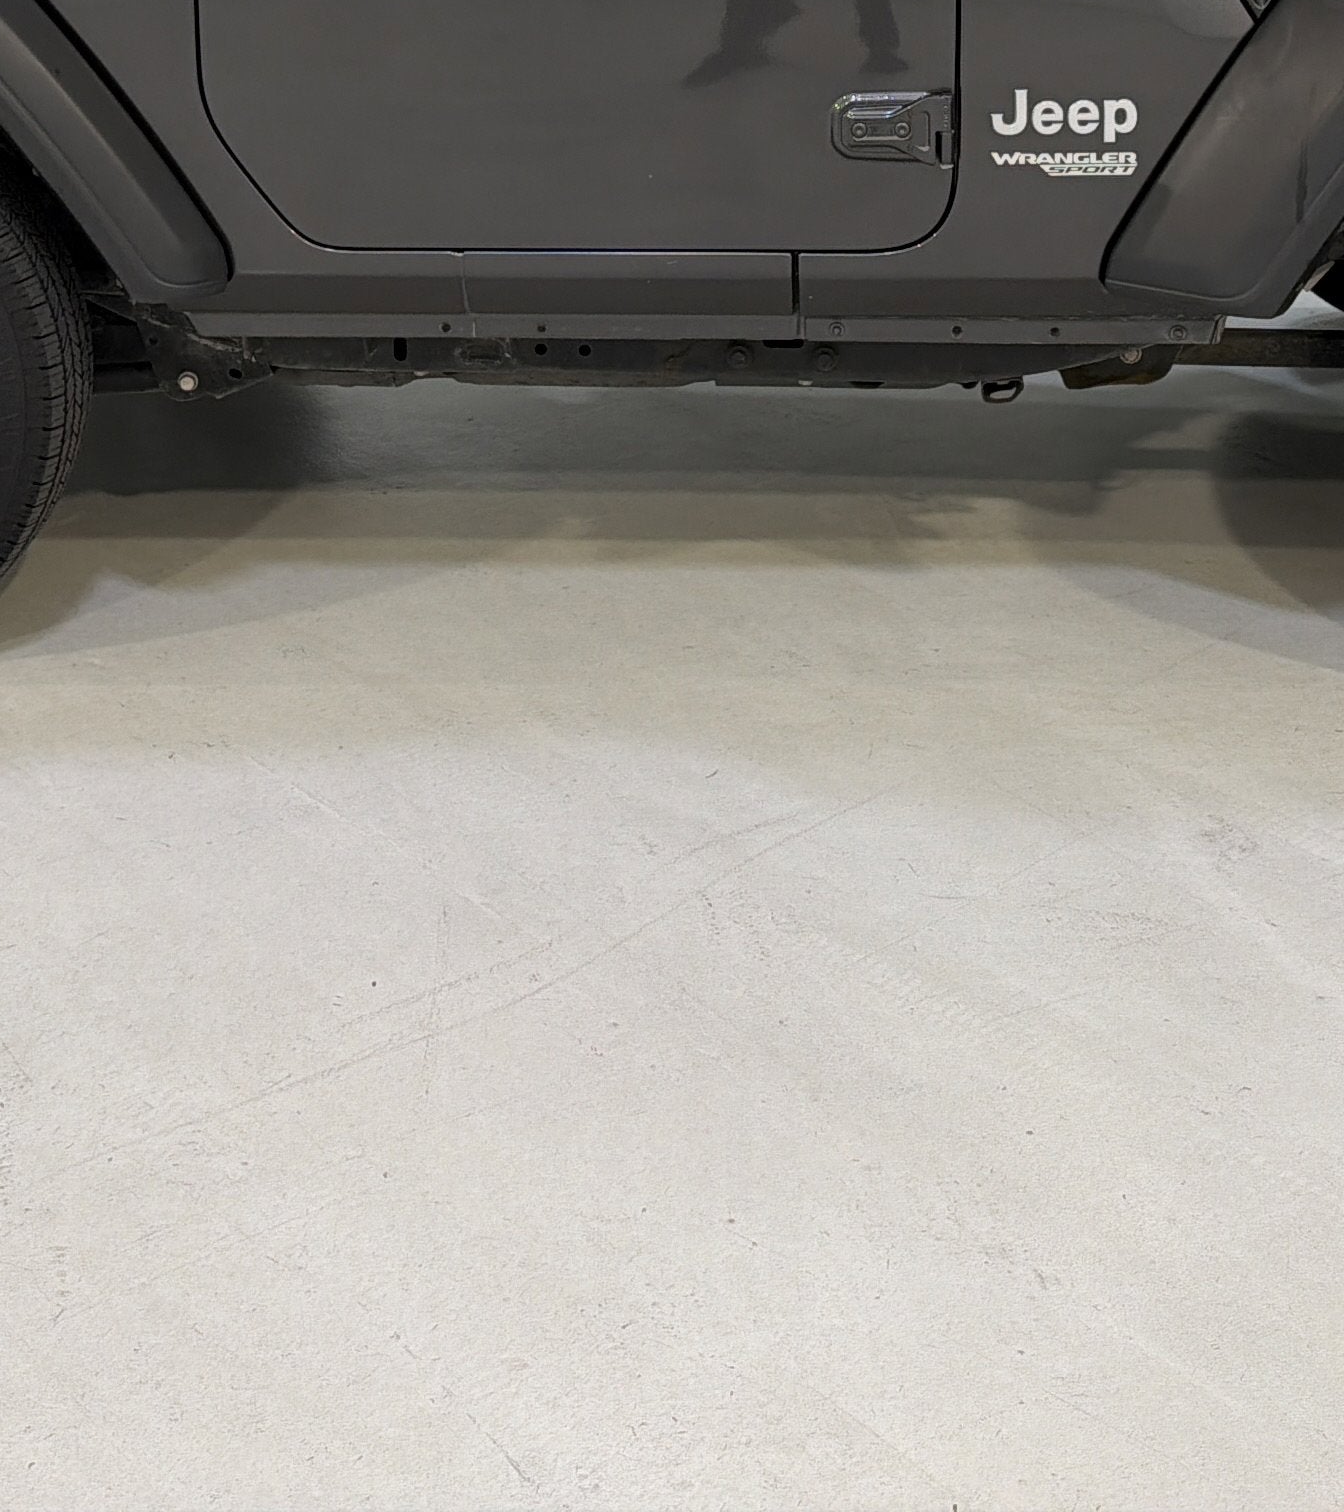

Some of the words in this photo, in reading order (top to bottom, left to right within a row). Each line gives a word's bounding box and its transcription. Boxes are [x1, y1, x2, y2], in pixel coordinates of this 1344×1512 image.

[991, 89, 1138, 143] Jeep
[991, 152, 1137, 165] WRANGLER
[1047, 165, 1131, 174] SPORT
